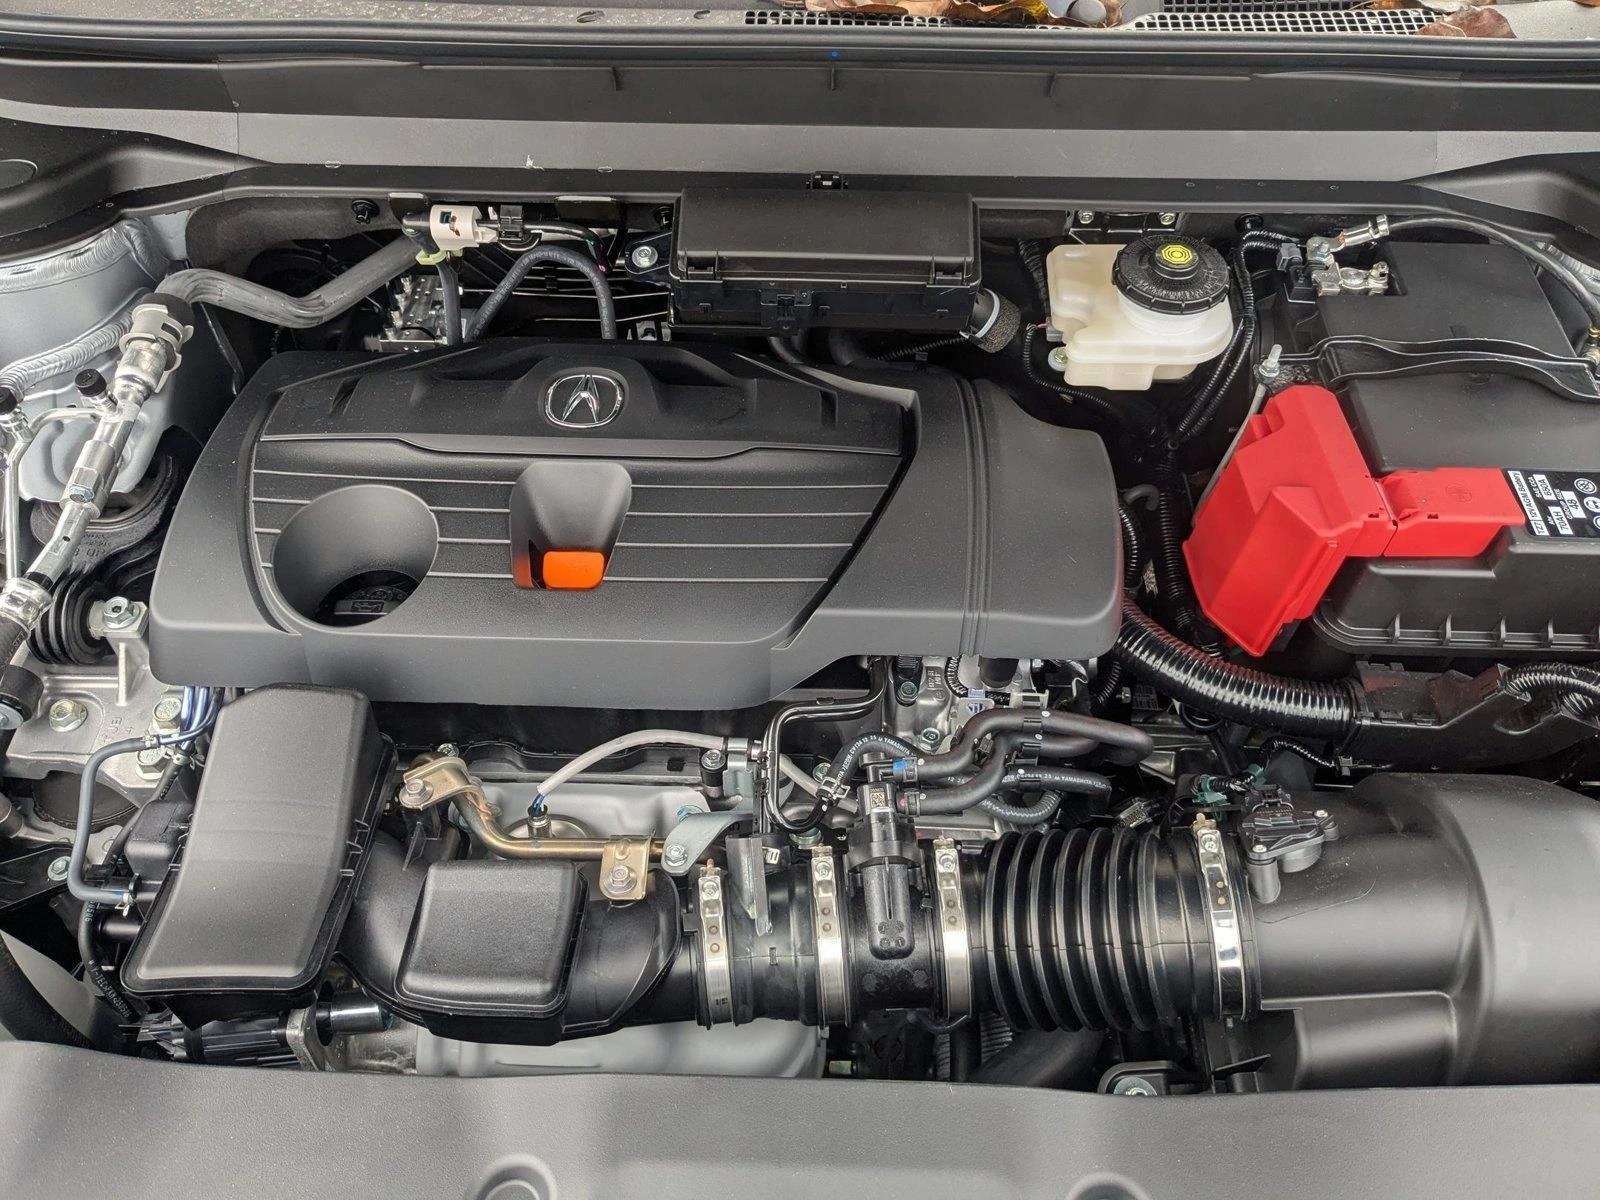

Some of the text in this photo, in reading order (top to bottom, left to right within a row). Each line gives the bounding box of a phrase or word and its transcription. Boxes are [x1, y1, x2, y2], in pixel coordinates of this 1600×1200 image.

[1512, 471, 1526, 491] Battery
[1538, 479, 1552, 495] 650A
[1520, 493, 1532, 506] AGM
[1567, 499, 1579, 509] 48
[1552, 511, 1568, 530] 70AH
[884, 738, 910, 755] YAMASHITA
